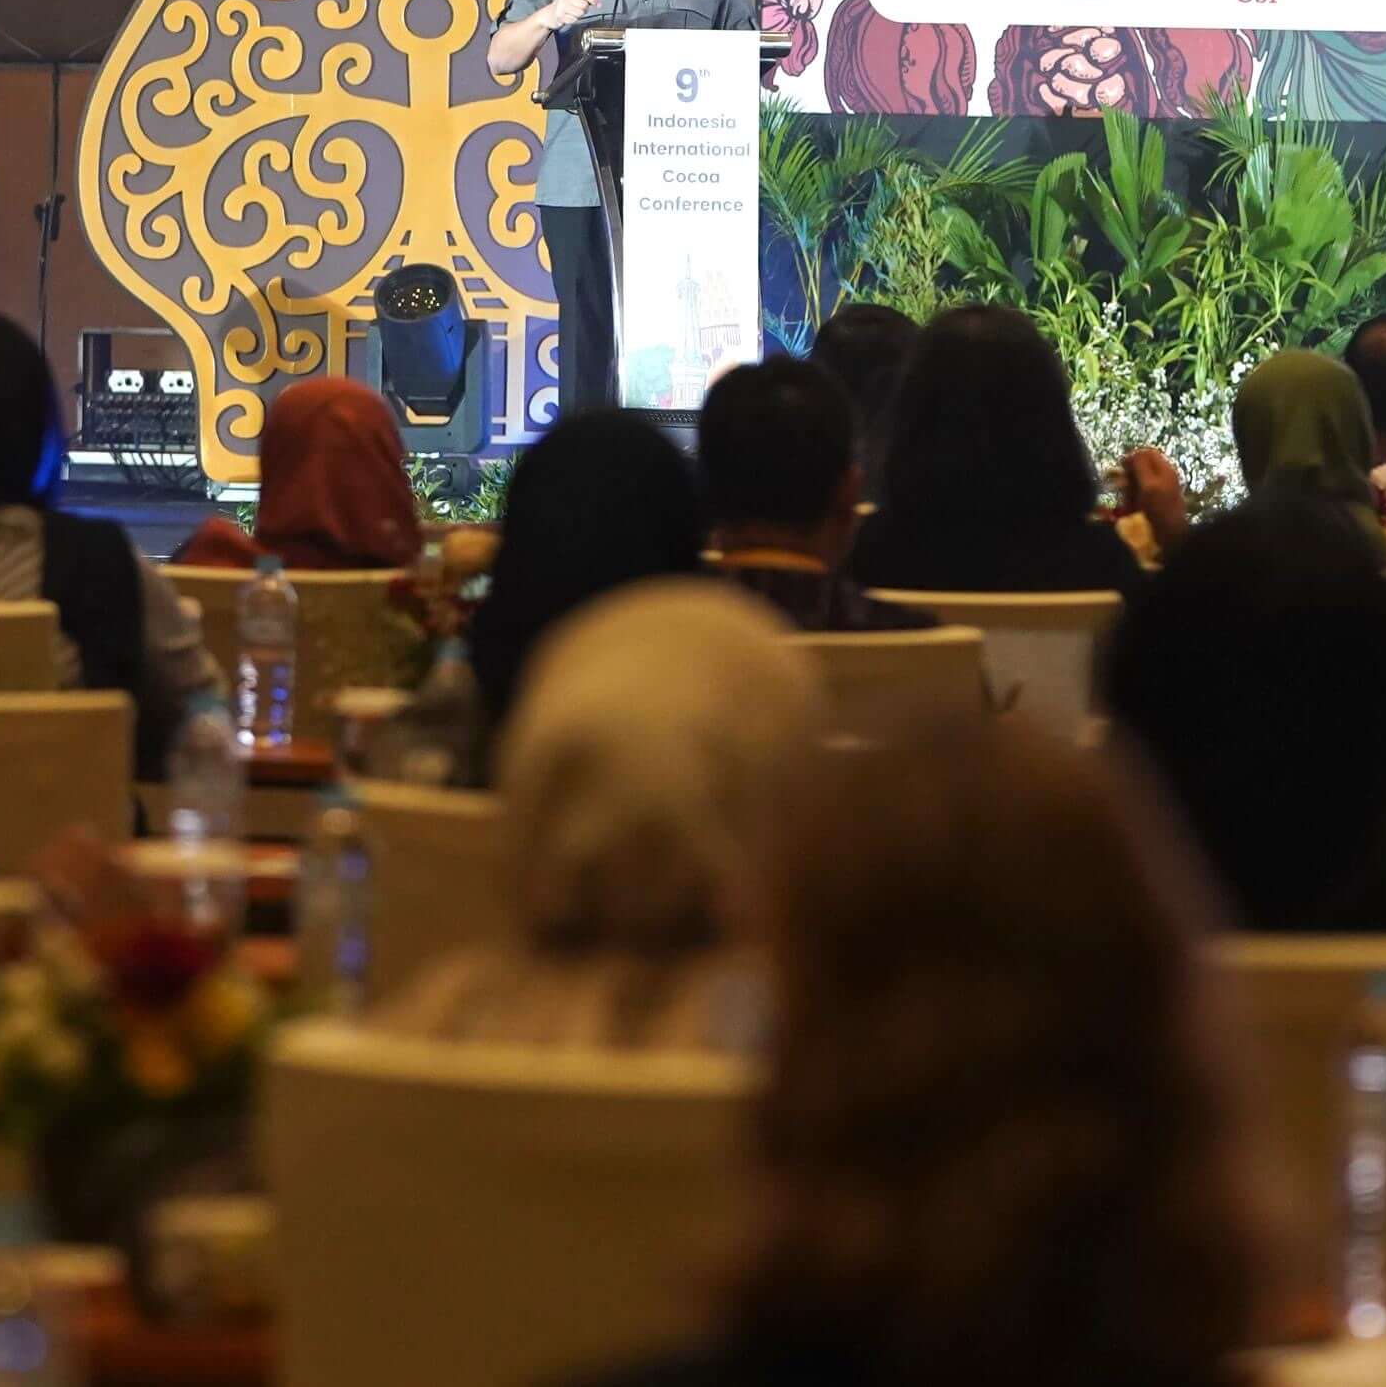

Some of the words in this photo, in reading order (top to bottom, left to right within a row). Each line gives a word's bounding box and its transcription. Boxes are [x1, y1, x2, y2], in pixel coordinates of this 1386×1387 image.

[648, 114, 737, 128] Indonesia
[633, 141, 750, 157] International
[663, 169, 720, 183] Cocoa
[639, 196, 744, 212] Conference
